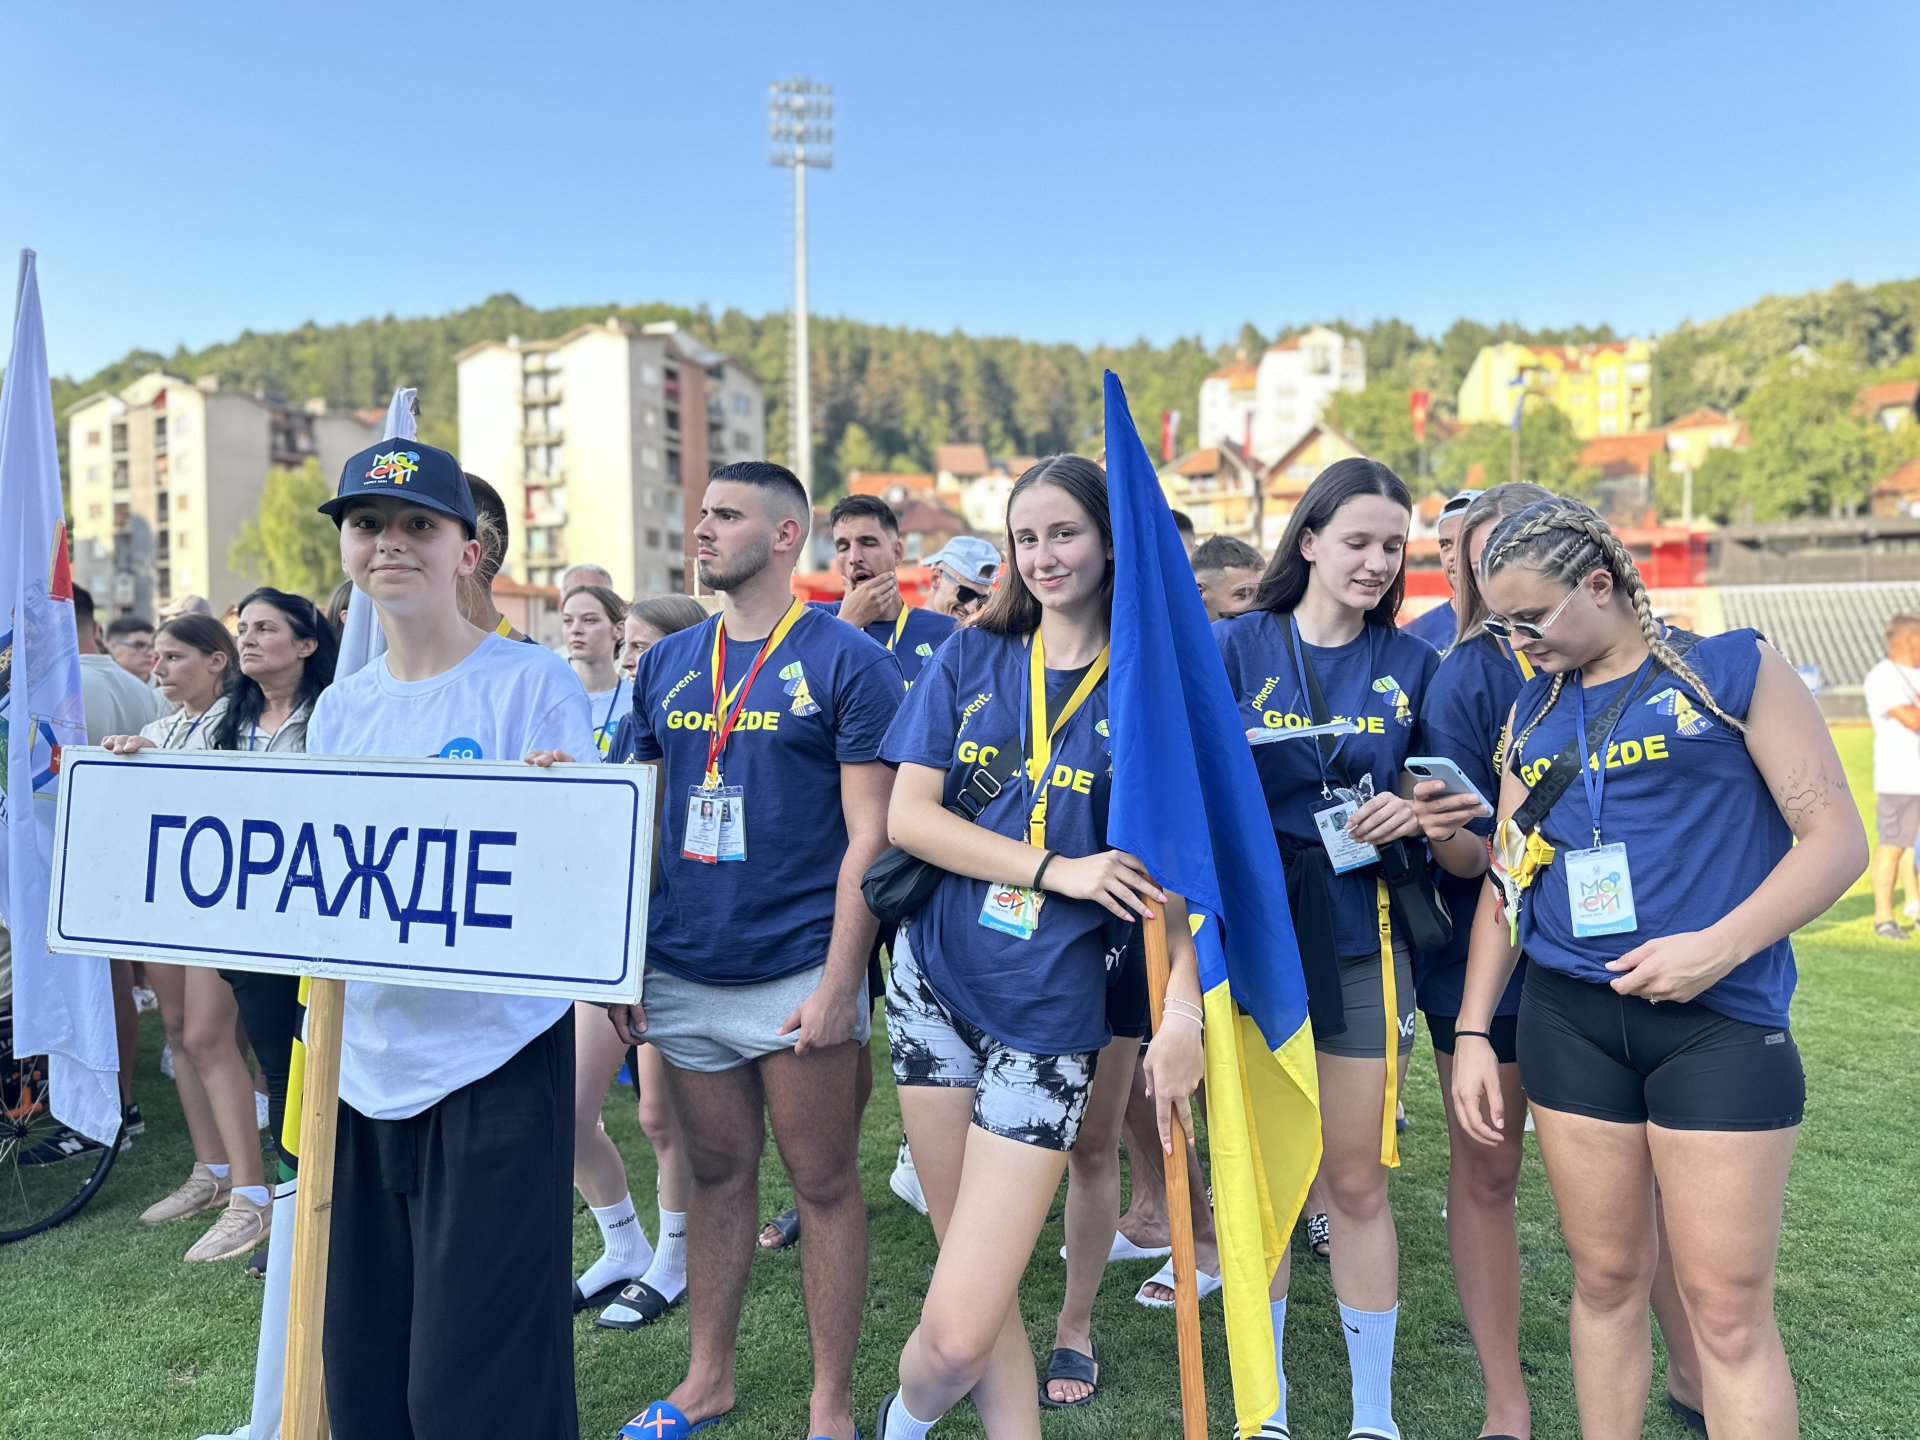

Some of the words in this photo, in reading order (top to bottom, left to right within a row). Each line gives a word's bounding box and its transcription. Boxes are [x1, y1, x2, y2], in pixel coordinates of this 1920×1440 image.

[661, 669, 702, 711] prevent.
[666, 708, 781, 732] GORŽDE
[1517, 771, 1568, 828] adidas
[144, 813, 518, 948] ГОРАЖДЕ
